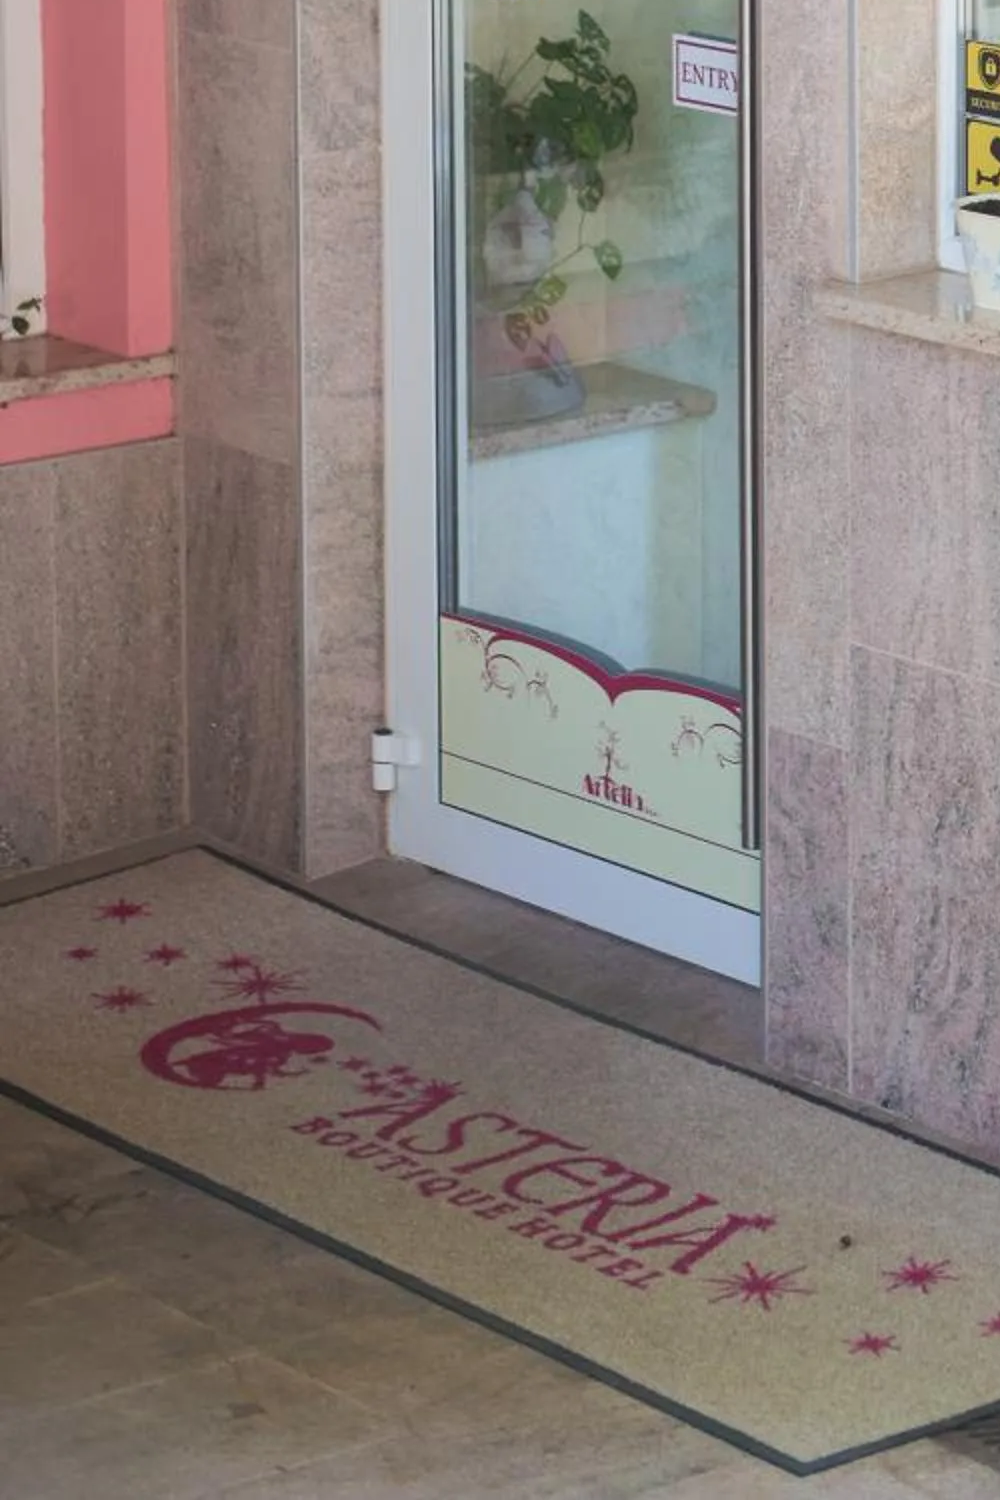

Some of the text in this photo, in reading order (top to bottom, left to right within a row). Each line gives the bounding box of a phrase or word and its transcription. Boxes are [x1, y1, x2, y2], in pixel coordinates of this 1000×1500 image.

[682, 61, 737, 93] ENTRY
[290, 1116, 665, 1291] BOUTIQUE HOTEL
[338, 1084, 748, 1276] ASTERIA
